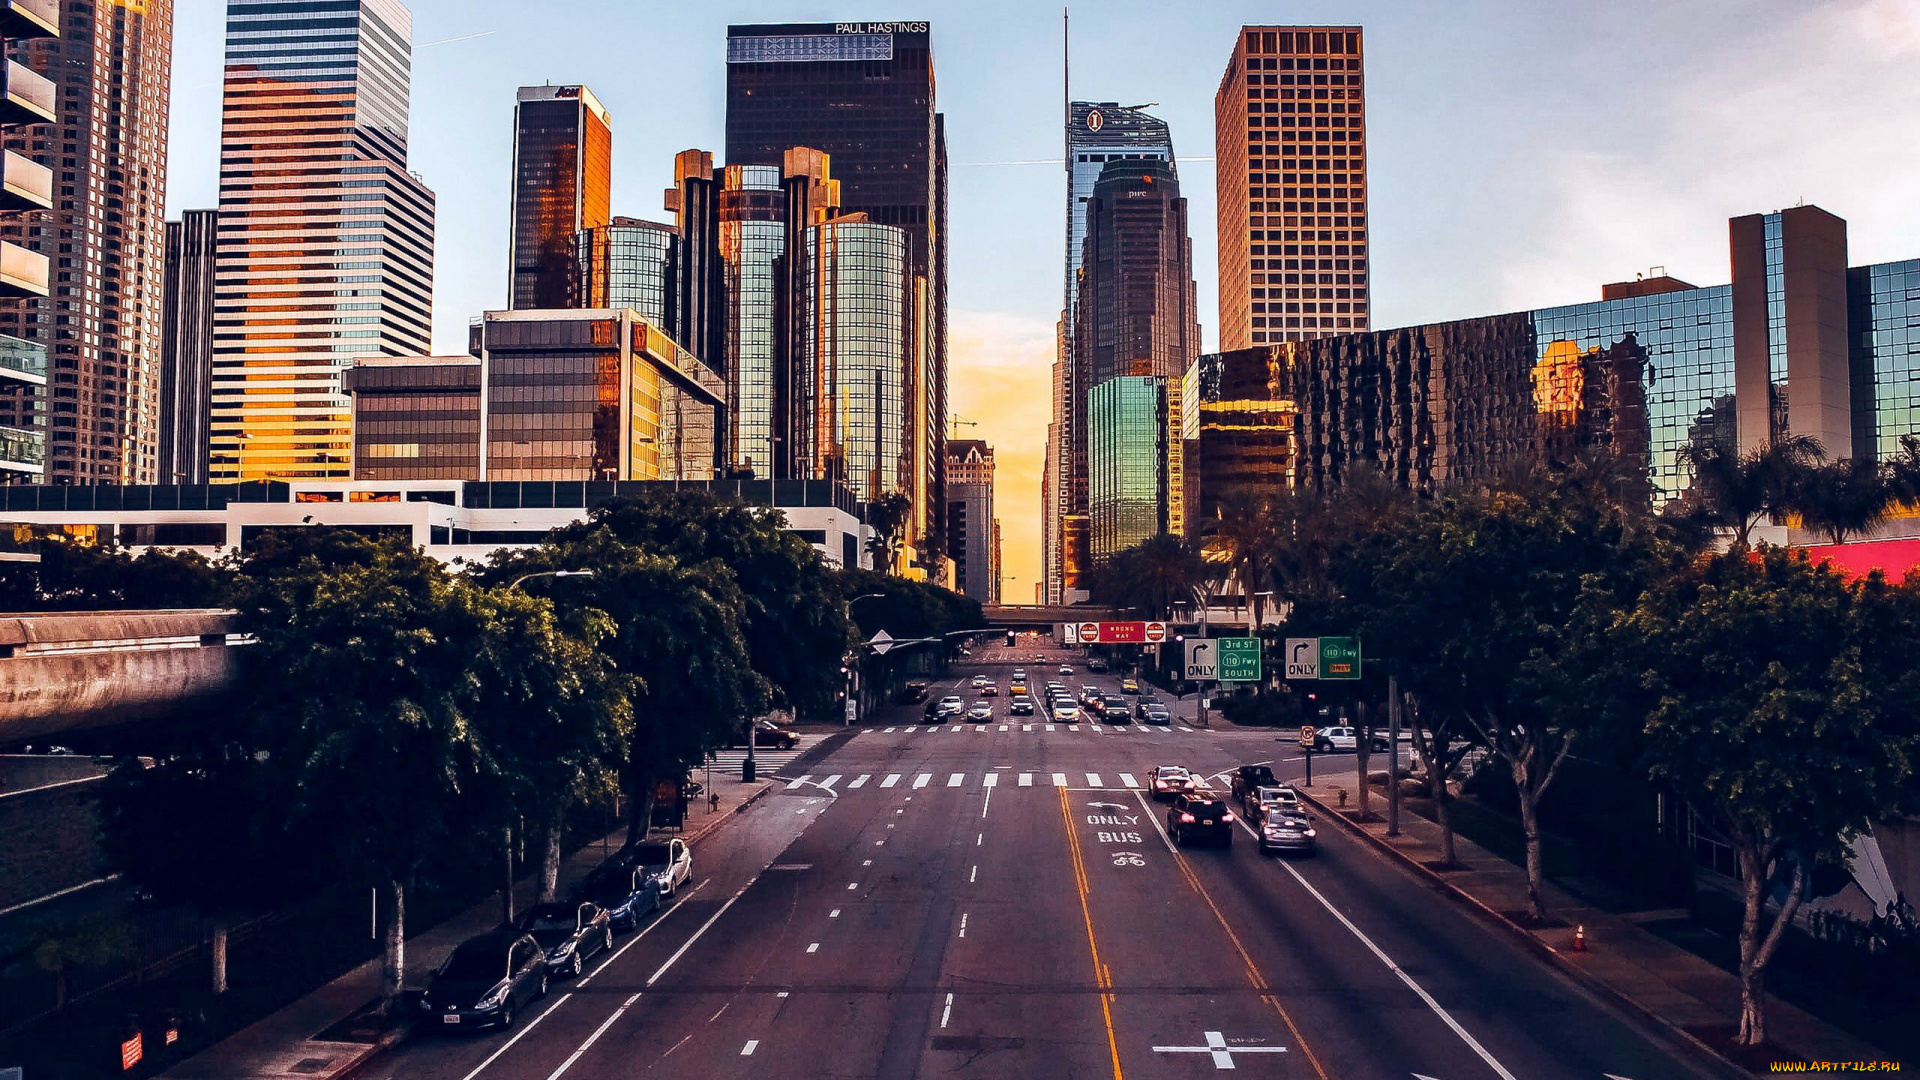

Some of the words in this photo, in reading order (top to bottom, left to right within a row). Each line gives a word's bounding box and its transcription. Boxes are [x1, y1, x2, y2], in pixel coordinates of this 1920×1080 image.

[836, 23, 865, 34] PAUL
[868, 22, 927, 33] HASTINGS
[1129, 191, 1147, 199] pwc
[1225, 640, 1241, 649] 3rd
[1327, 649, 1338, 657] 110
[1226, 657, 1238, 665] 110
[1242, 658, 1257, 666] Fwy
[1187, 665, 1216, 677] ONLY
[1224, 669, 1254, 677] SOUTH
[1288, 664, 1317, 675] ONLY
[1087, 815, 1138, 825] ONLY
[1098, 832, 1142, 843] BUS
